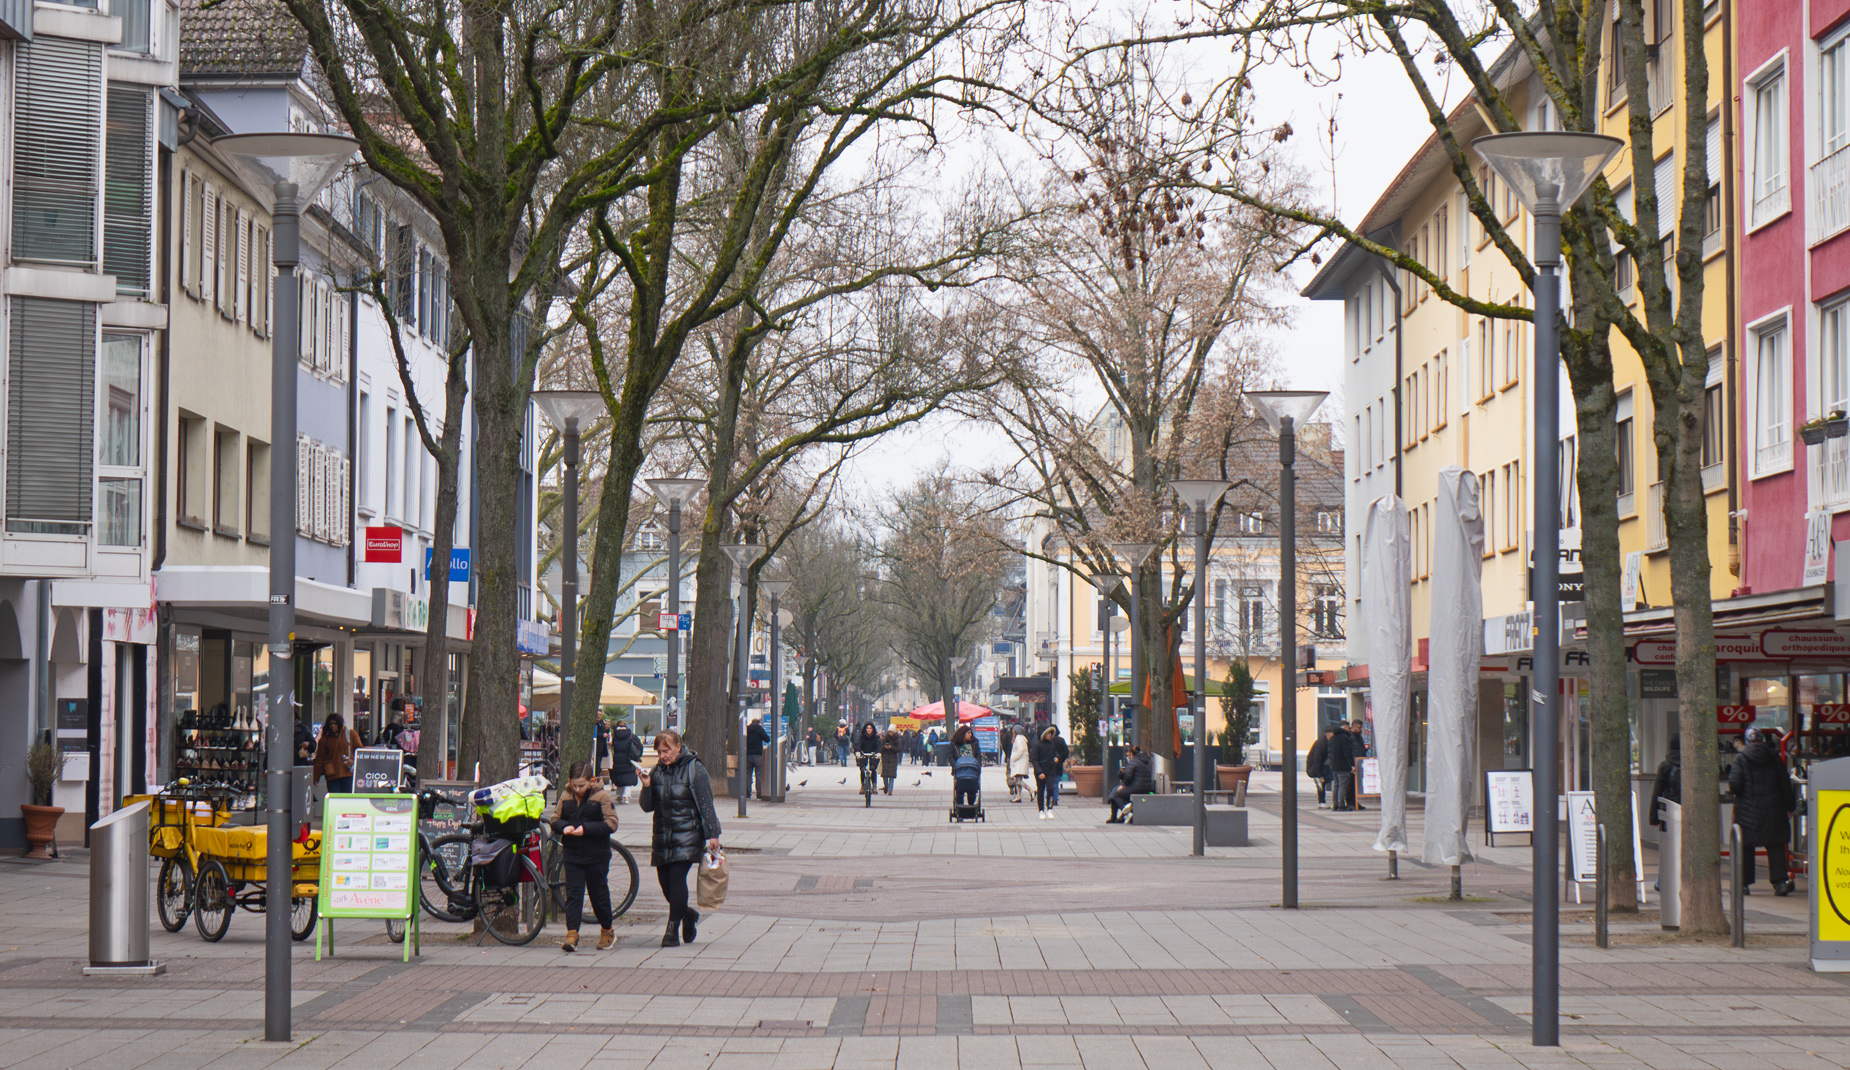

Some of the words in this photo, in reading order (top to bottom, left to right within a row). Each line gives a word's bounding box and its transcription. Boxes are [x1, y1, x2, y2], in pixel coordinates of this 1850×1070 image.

[368, 541, 398, 549] EuroShop
[1788, 634, 1845, 643] chaussures
[1657, 644, 1676, 652] chau
[1781, 643, 1850, 653] orthopediques
[365, 772, 388, 780] CICO
[1835, 867, 1850, 876] No
[349, 892, 384, 905] Avène
